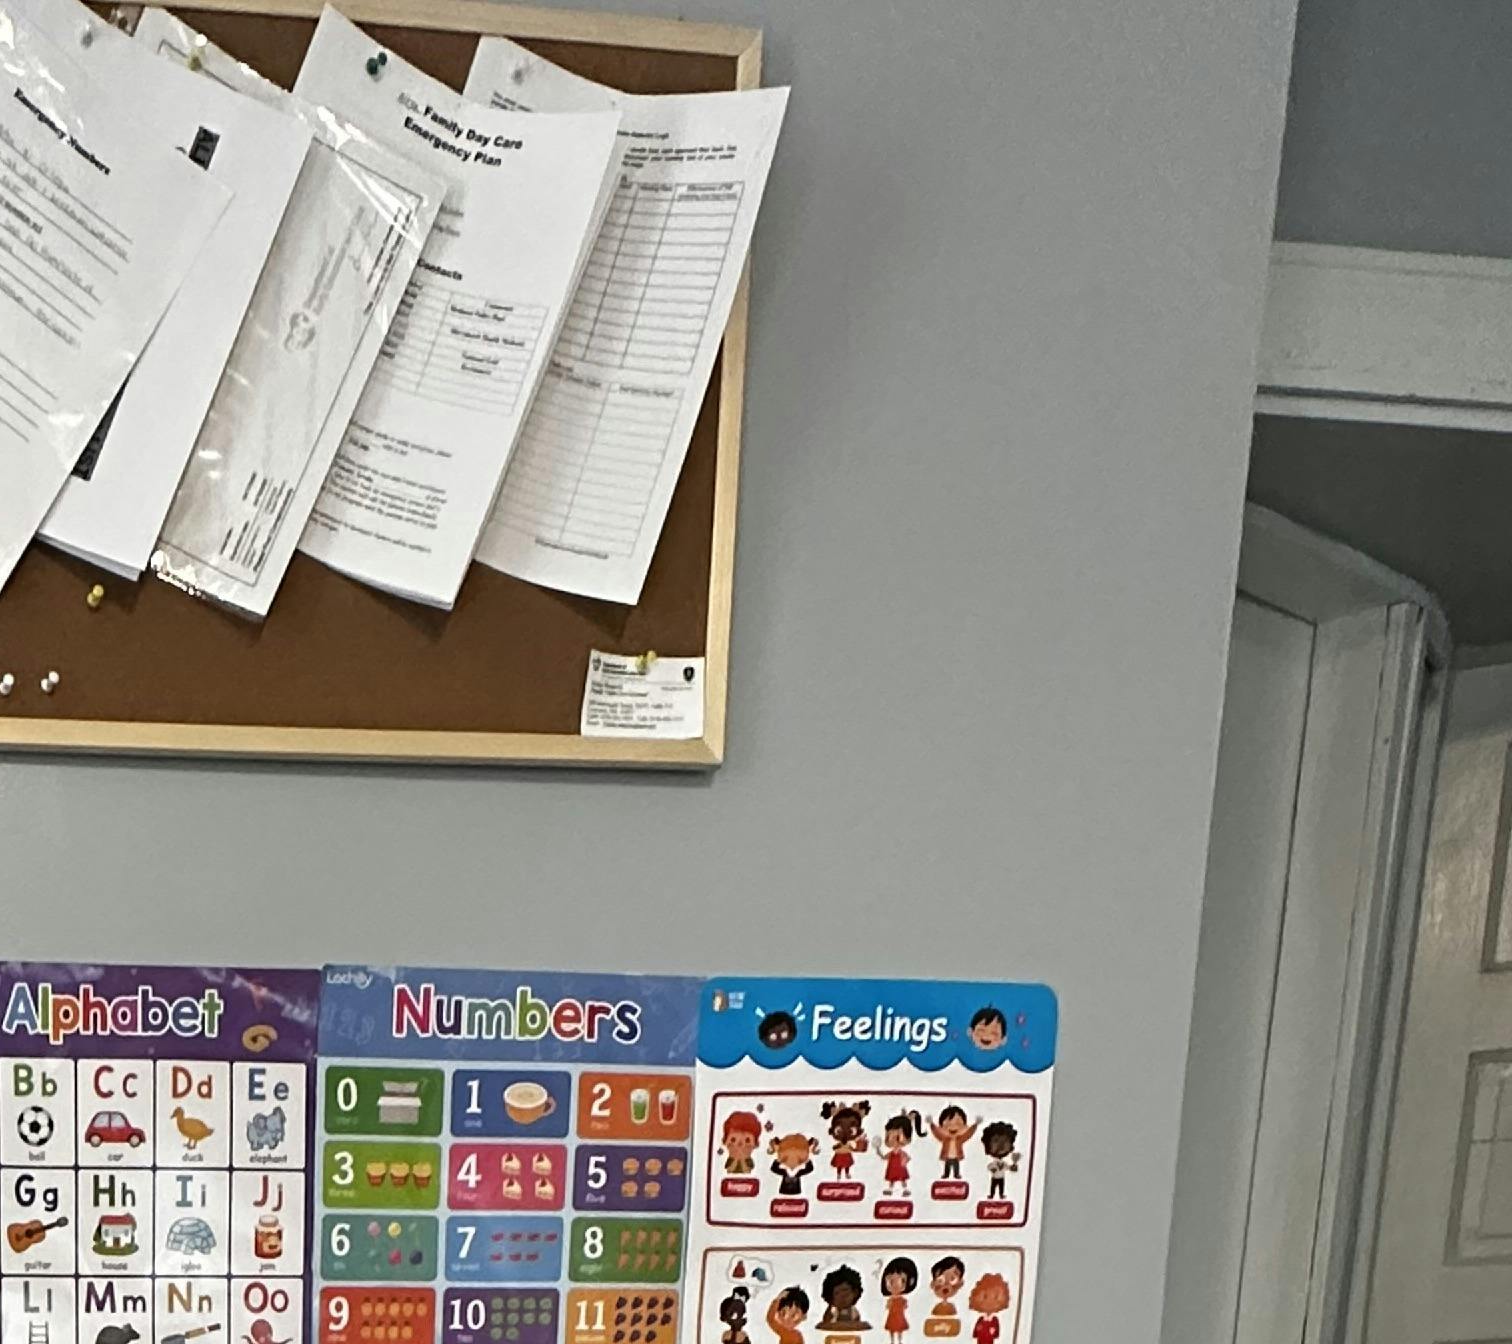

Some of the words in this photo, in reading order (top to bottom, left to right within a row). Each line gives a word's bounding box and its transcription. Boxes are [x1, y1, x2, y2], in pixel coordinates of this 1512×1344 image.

[404, 116, 471, 162] Emergency
[474, 151, 502, 166] Plan
[424, 105, 463, 138] Family
[466, 129, 491, 147] Day
[494, 136, 523, 149] Care
[2, 982, 224, 1045] Alphabet
[392, 982, 641, 1044] Numbers
[810, 1003, 948, 1053] Feelings
[13, 1064, 58, 1097] Bb
[93, 1065, 138, 1098] Cc
[171, 1066, 213, 1099] Dd
[248, 1068, 289, 1101] Ee
[336, 1077, 358, 1112] 0
[465, 1079, 483, 1114] 1
[590, 1083, 612, 1118] 2
[332, 1151, 354, 1186] 3
[456, 1152, 482, 1188] 4
[587, 1155, 608, 1189] 5
[15, 1174, 59, 1212] Gg
[93, 1175, 136, 1208] Hh
[176, 1175, 206, 1208] Ii
[253, 1175, 284, 1211] Jj
[330, 1223, 351, 1257] 6
[456, 1226, 476, 1260] 7
[582, 1226, 604, 1260] 8
[84, 1281, 146, 1313] Mm
[168, 1282, 212, 1313] Nn
[243, 1282, 290, 1314] Oo
[328, 1296, 350, 1331] 9
[449, 1299, 486, 1330] 10
[575, 1301, 607, 1331] 11
